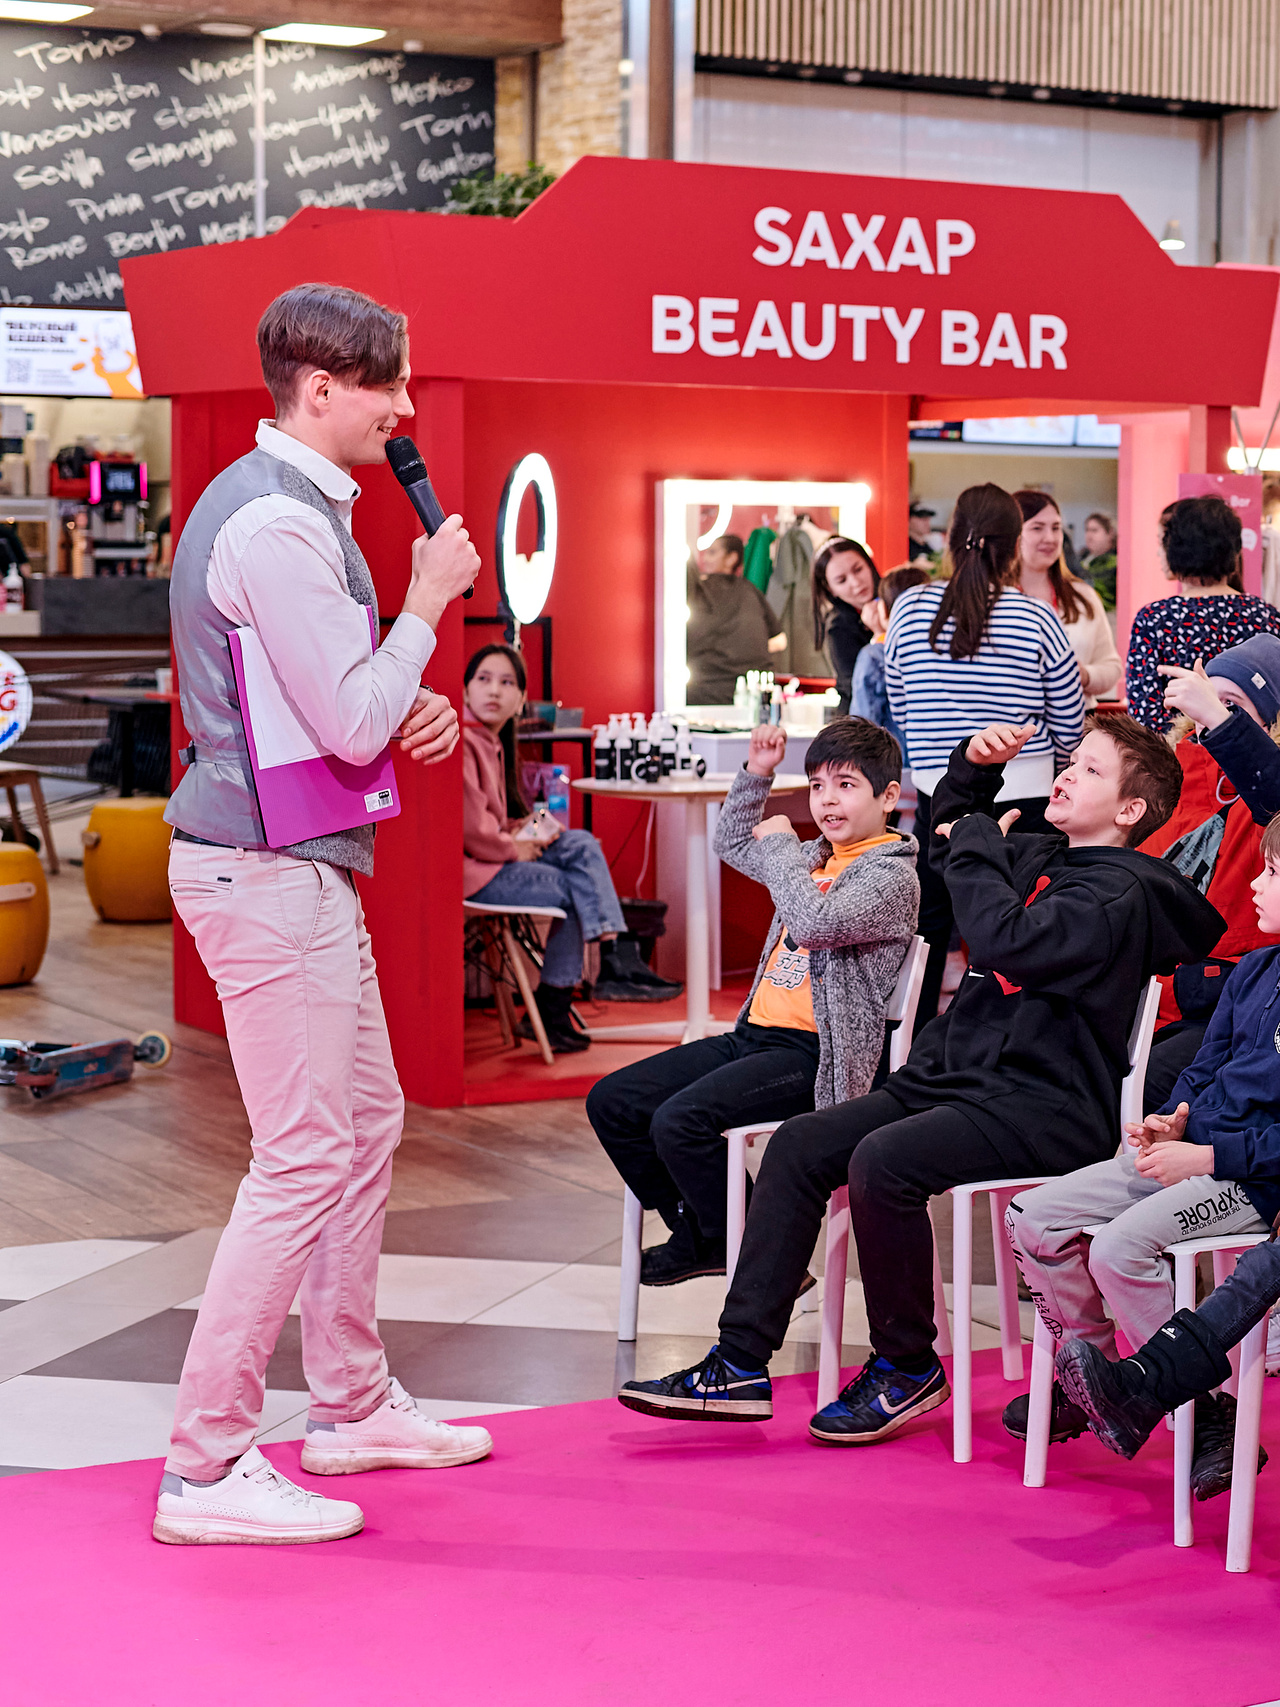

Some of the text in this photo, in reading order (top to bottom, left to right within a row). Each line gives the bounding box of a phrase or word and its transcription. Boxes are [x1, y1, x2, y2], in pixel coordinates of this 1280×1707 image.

[13, 31, 136, 72] Torino
[52, 72, 161, 113] Houston
[5, 234, 88, 271] Rome
[103, 218, 186, 258] Berlin
[199, 211, 288, 246] Mexio
[652, 294, 1068, 370] BEAUTY BAR
[1190, 1222, 1207, 1233] YOURS
[1213, 1210, 1231, 1224] WORLD
